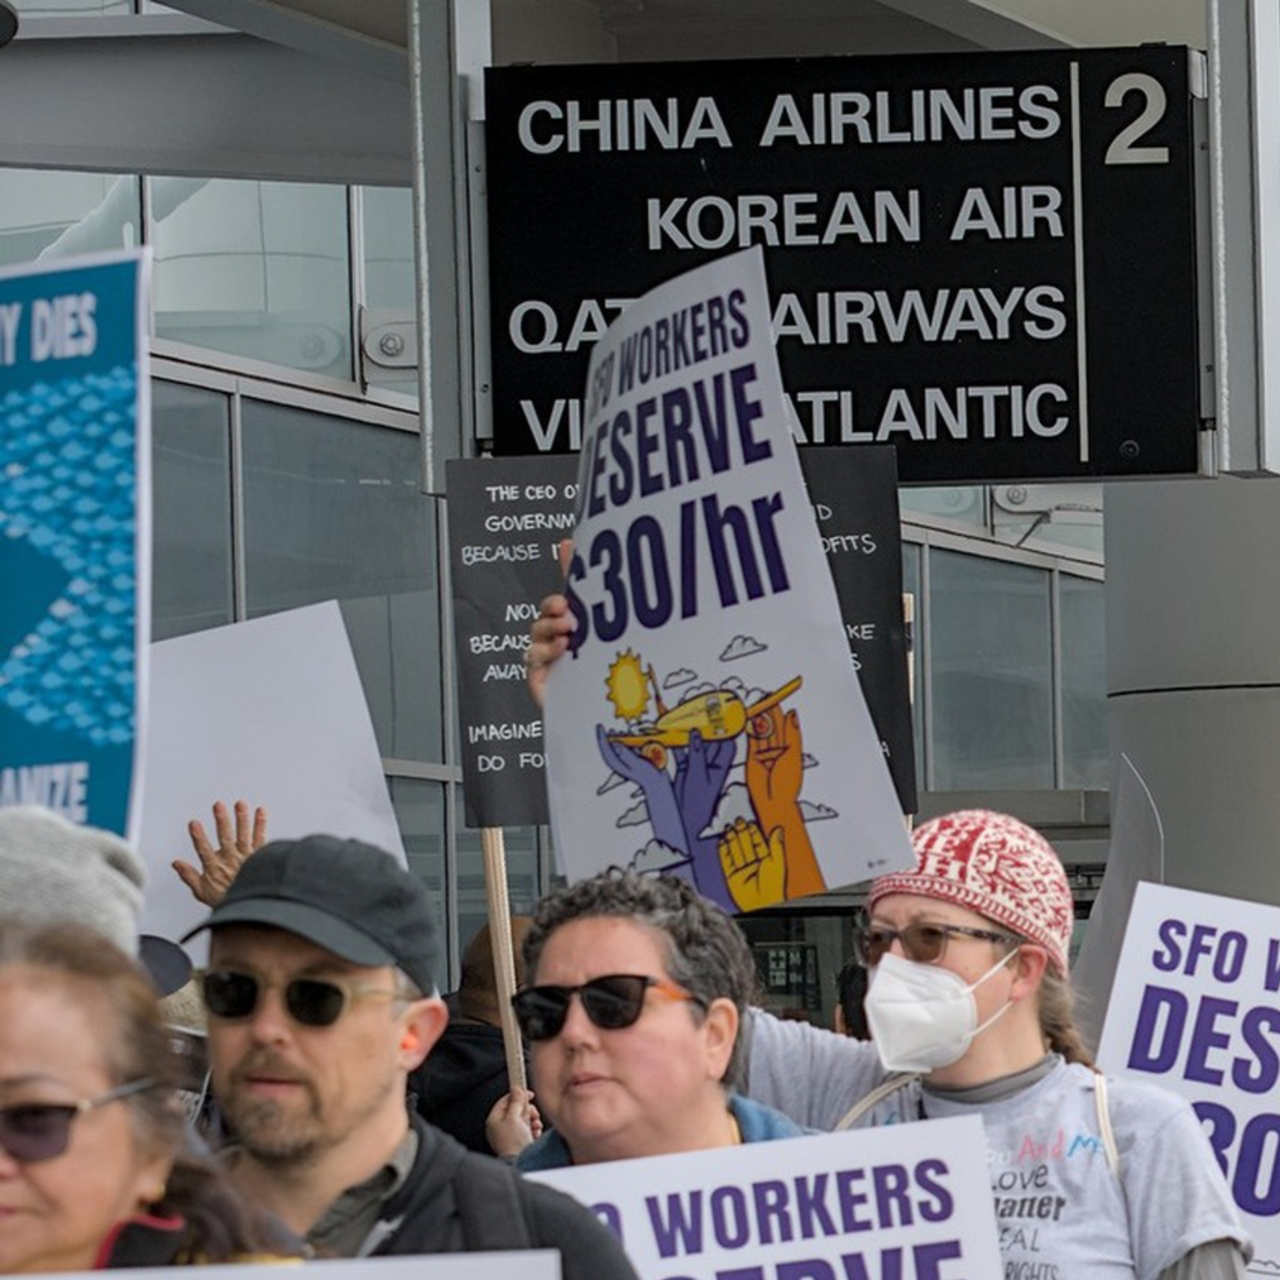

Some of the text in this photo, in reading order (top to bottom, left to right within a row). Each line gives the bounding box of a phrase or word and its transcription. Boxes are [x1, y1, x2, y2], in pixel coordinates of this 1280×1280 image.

[518, 85, 1062, 154] CHINA AIRLINES
[1104, 72, 1170, 166] 2
[647, 186, 1065, 250] KOREAN AIR
[31, 291, 97, 362] DIES
[618, 287, 750, 398] WORKERS
[771, 286, 1067, 344] AIRWAYS
[485, 485, 520, 502] THE
[525, 485, 556, 500] CEO
[461, 543, 541, 566] BECAUSE
[483, 663, 528, 682] AWAY
[468, 720, 543, 744] IMAGINE
[478, 754, 505, 772] DO
[1152, 917, 1249, 984] SFO
[992, 1164, 1049, 1191] ove
[644, 1158, 955, 1259] WORKERS
